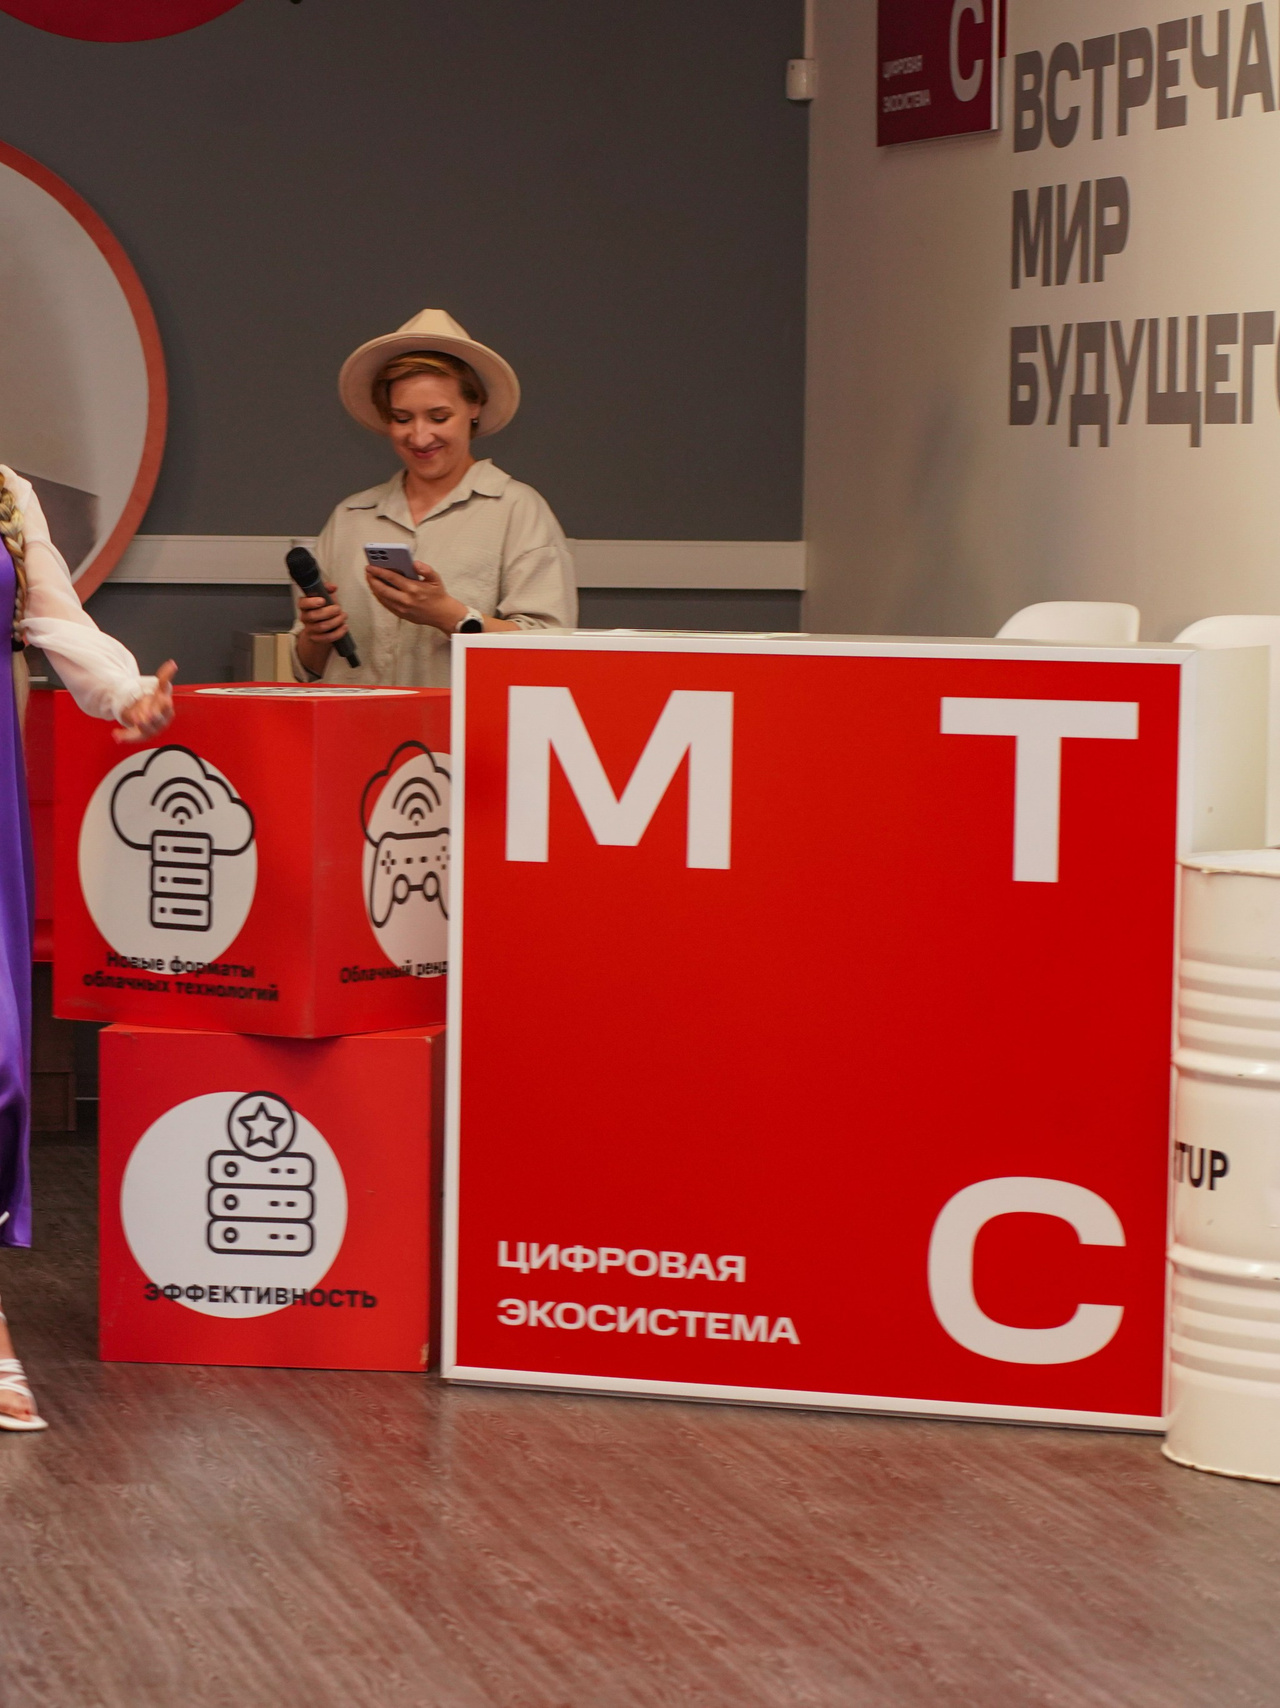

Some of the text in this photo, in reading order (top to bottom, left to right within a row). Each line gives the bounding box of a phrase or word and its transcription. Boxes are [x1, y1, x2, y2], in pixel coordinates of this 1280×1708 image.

[1014, 2, 1280, 153] ВСТРЕЧА
[1011, 176, 1130, 289] МИР
[1009, 310, 1280, 447] БУДУЩЕГ
[82, 970, 280, 1002] облачных технологий
[106, 951, 256, 979] Новые форматы
[1174, 1140, 1230, 1191] TUP
[497, 1240, 747, 1283] ЦИФРОВАЯ
[143, 1283, 379, 1310] ЭФФЕКТИВНОСТЬ
[497, 1298, 801, 1345] ЭКОСИСТЕМА
